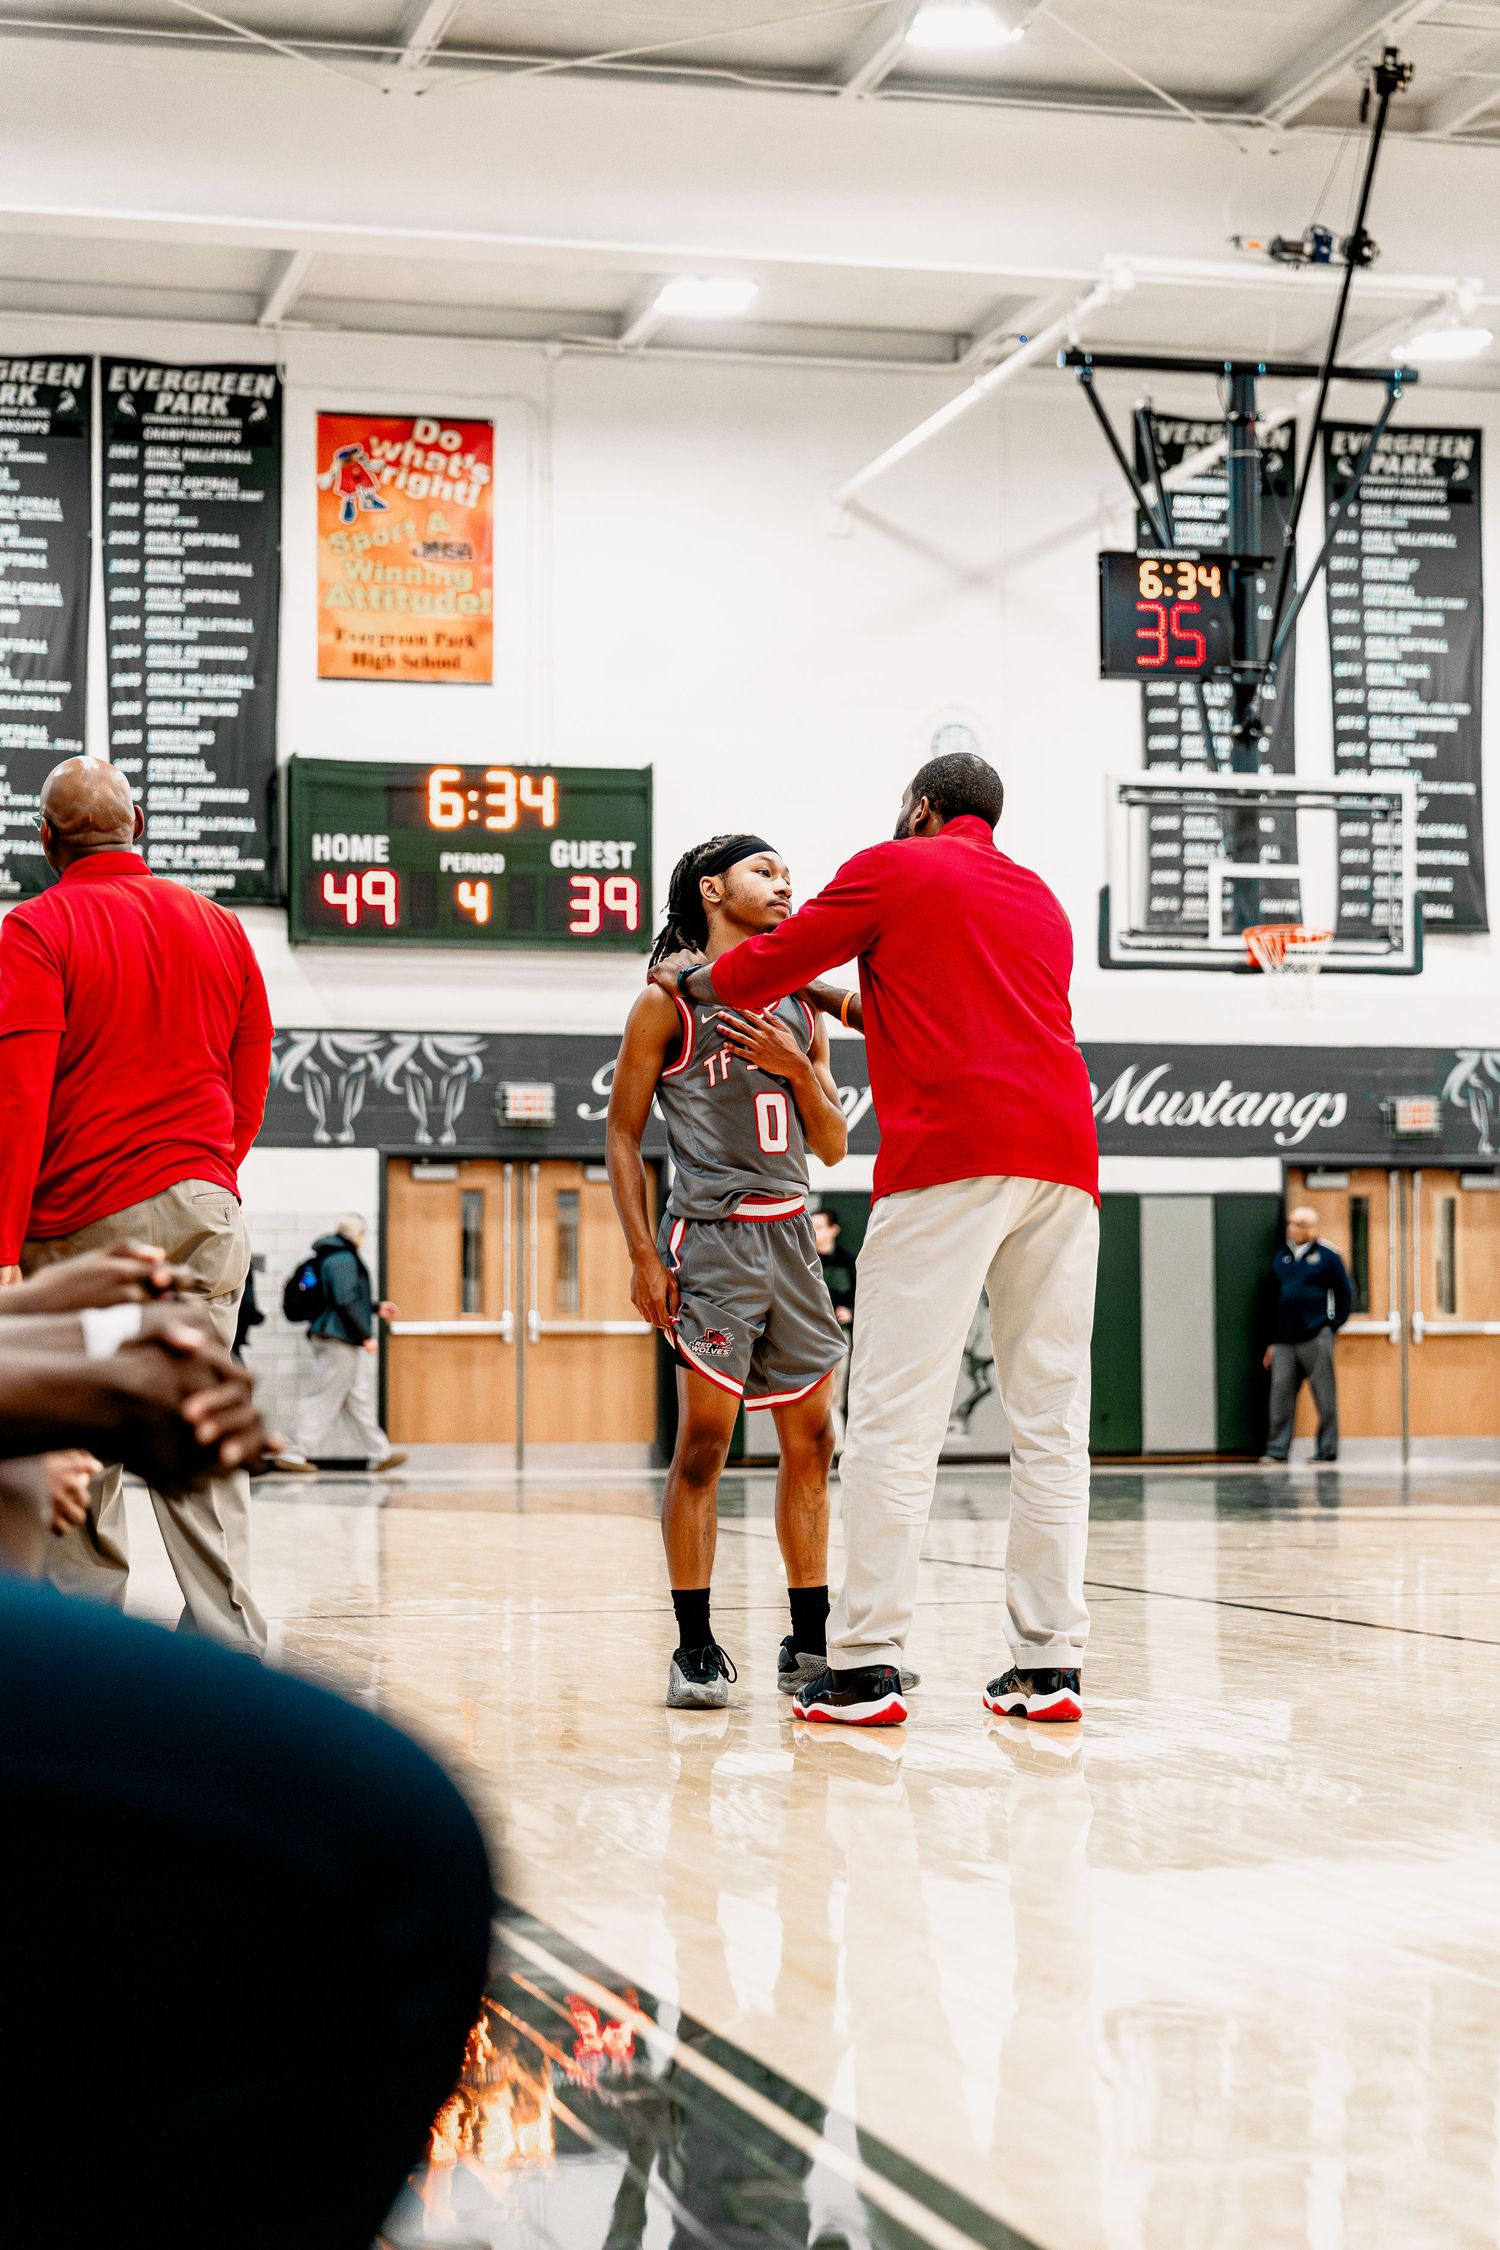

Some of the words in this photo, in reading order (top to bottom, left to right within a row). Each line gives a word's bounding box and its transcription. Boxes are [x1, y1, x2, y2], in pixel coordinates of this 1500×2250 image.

[107, 365, 277, 400] EVERGREEN
[154, 391, 230, 417] PARK
[413, 418, 463, 452] Do
[369, 435, 491, 486] what's
[1368, 453, 1437, 477] PARK
[327, 517, 417, 558] Sport
[427, 510, 451, 538] A
[342, 557, 474, 594] Winning
[1138, 559, 1222, 601] 6:34
[323, 579, 493, 618] Attitude!
[434, 631, 477, 651] Park
[1135, 600, 1207, 669] 35
[350, 651, 397, 673] High
[401, 653, 464, 671] School
[426, 765, 558, 831] 6:34
[310, 832, 391, 865] HOME
[438, 851, 507, 876] PERIOD
[549, 838, 638, 871] GUEST
[320, 868, 400, 928] 49
[455, 879, 492, 925] 4
[566, 874, 642, 937] 39
[703, 1048, 733, 1088] TF
[753, 1090, 790, 1155] 0
[1094, 1062, 1348, 1147] Mustangs
[691, 1345, 731, 1356] WOLVES
[694, 1340, 713, 1348] RED
